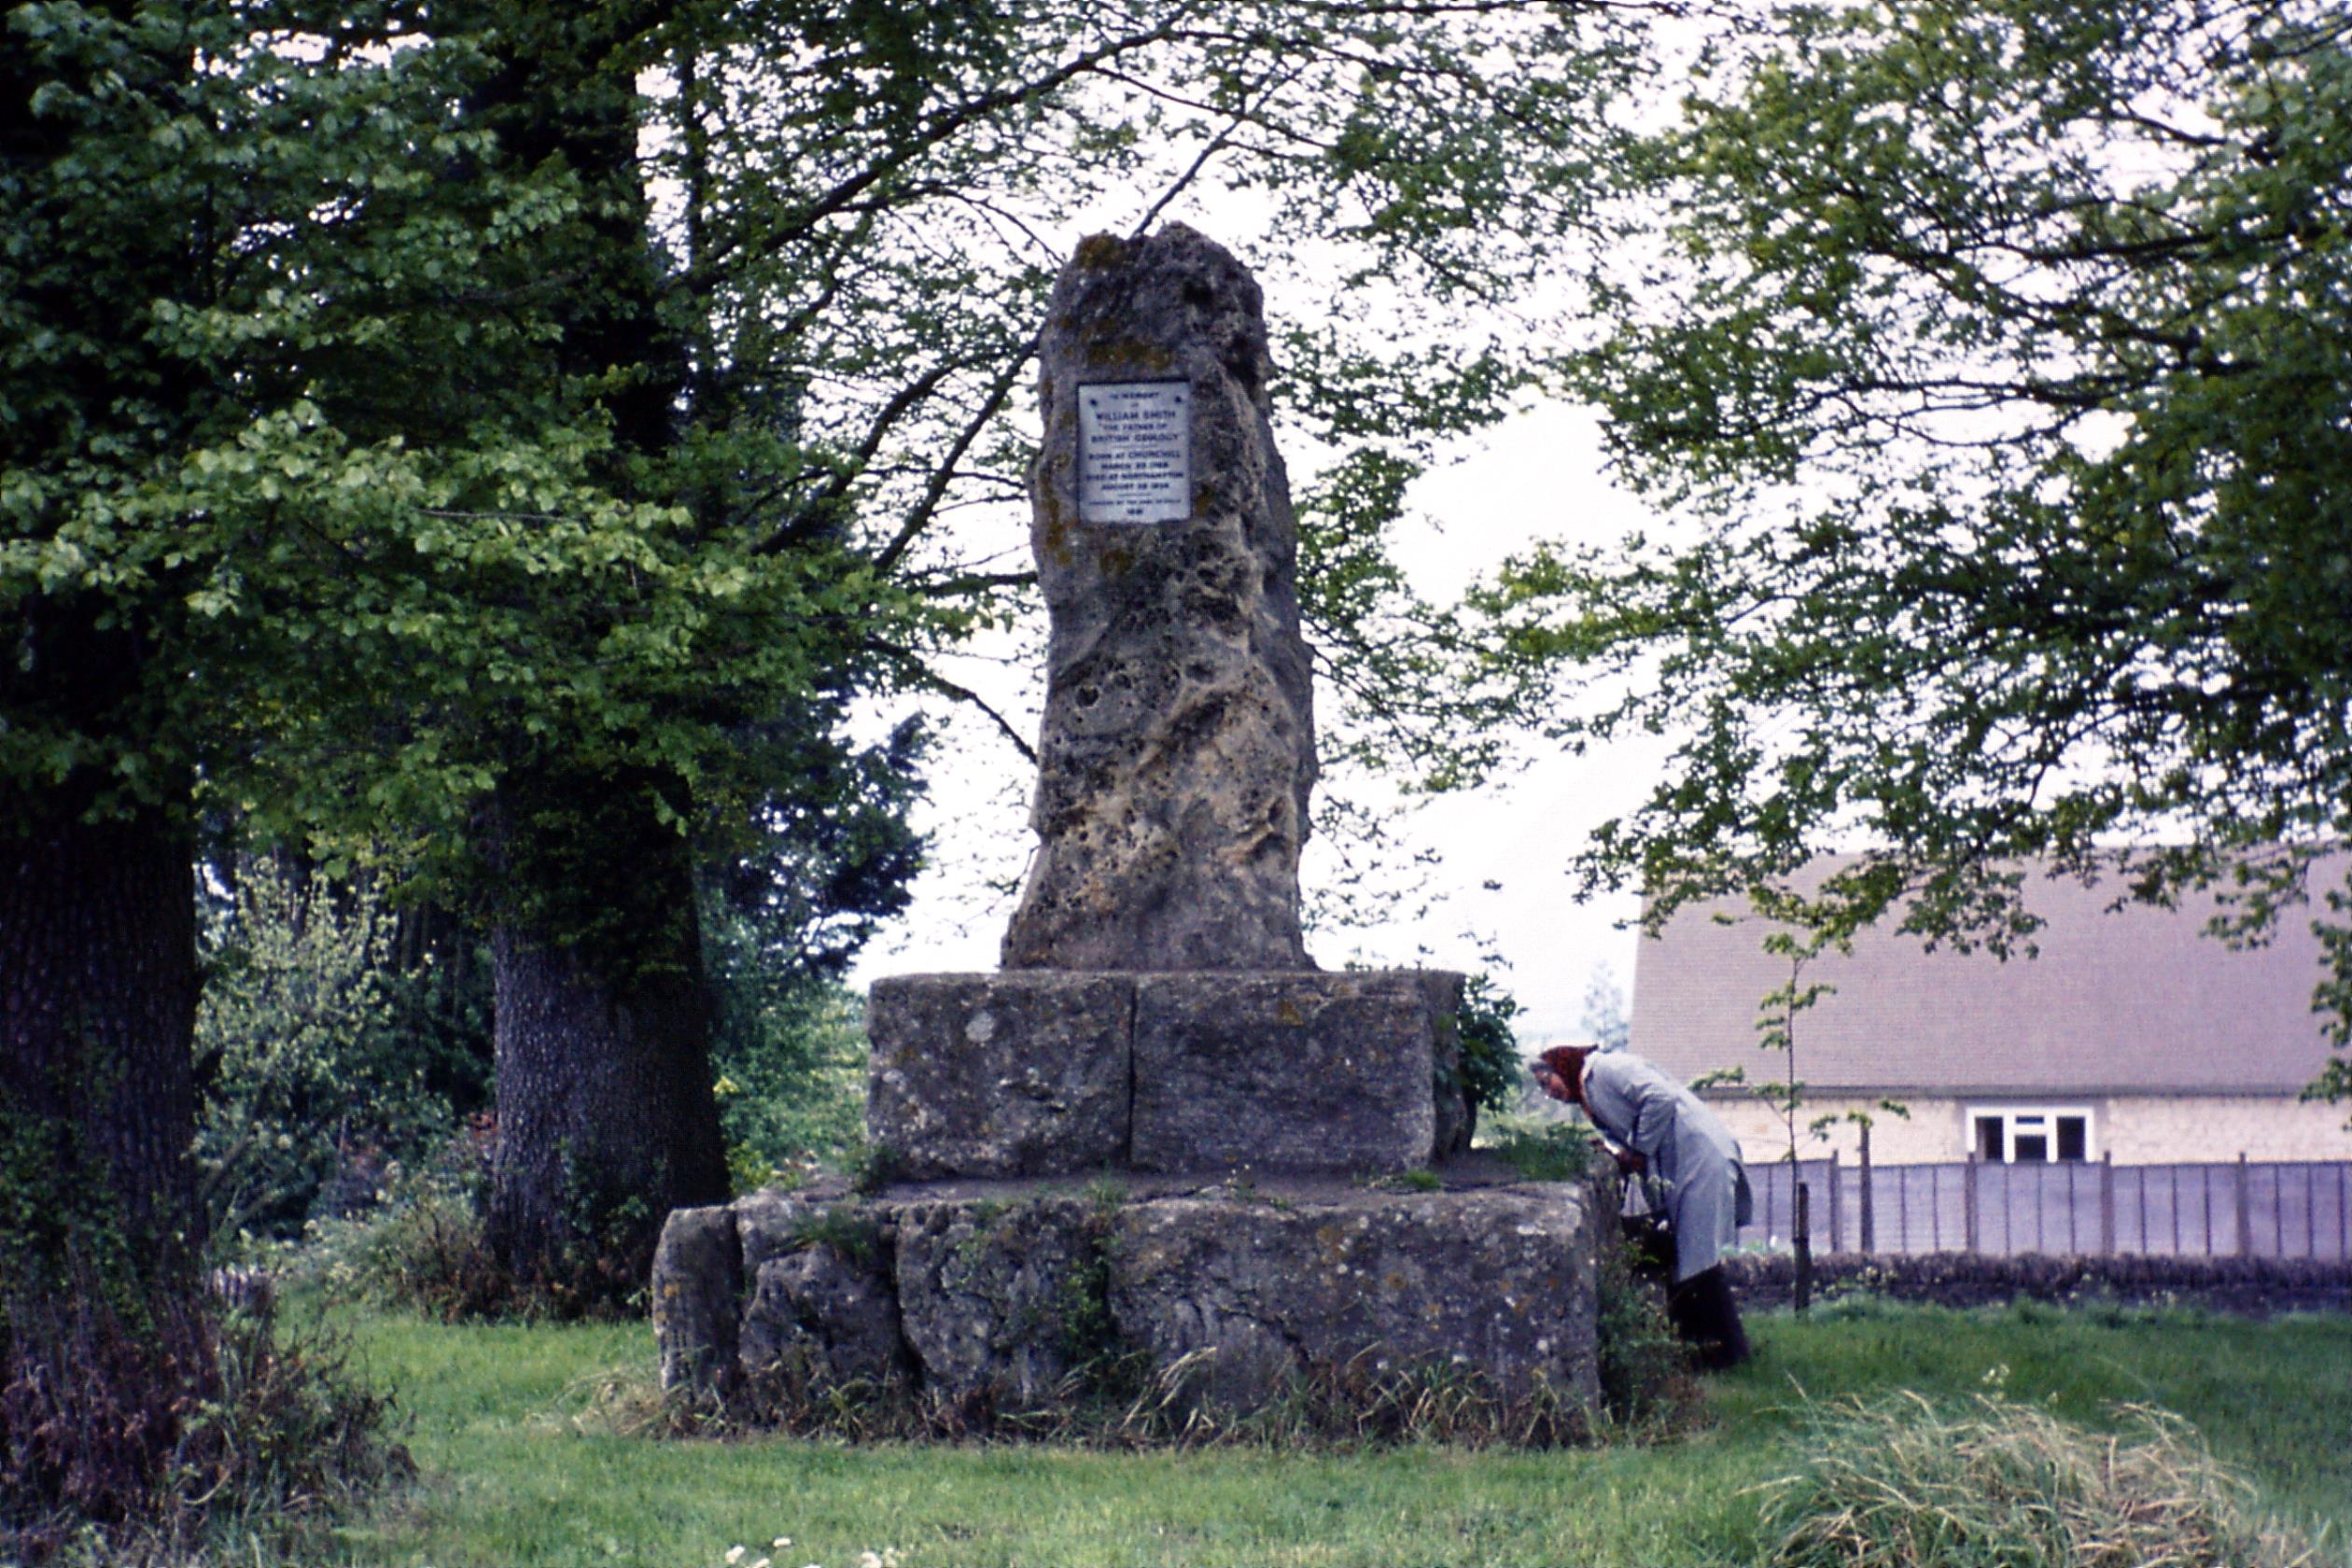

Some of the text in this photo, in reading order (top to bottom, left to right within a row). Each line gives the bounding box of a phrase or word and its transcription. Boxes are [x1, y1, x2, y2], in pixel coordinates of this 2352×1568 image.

[1097, 410, 1176, 420] WILLIAM SMITH
[1091, 434, 1129, 442] BRITISH
[1128, 450, 1181, 459] CHURCHILL
[1122, 470, 1183, 479] NORTHAMPTON
